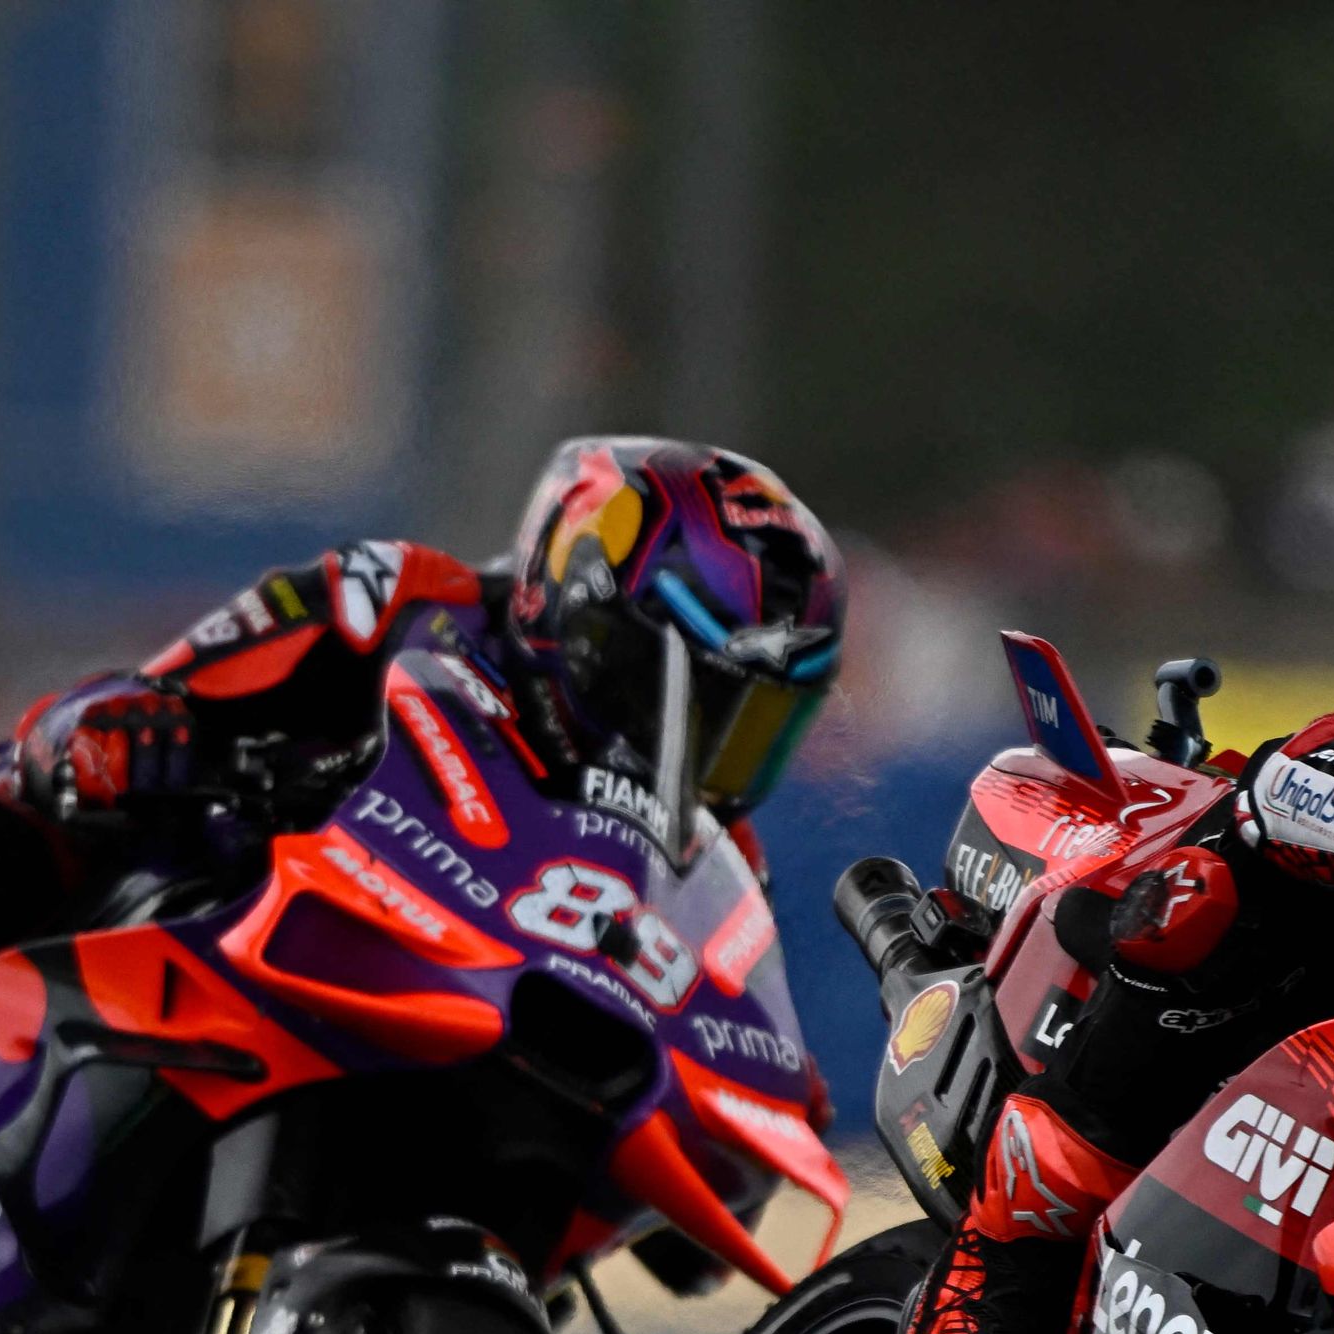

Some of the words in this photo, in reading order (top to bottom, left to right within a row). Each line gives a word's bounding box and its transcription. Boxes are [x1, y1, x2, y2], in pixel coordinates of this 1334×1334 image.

[1027, 687, 1058, 728] TIM
[356, 787, 501, 909] prima
[692, 1015, 801, 1073] prima
